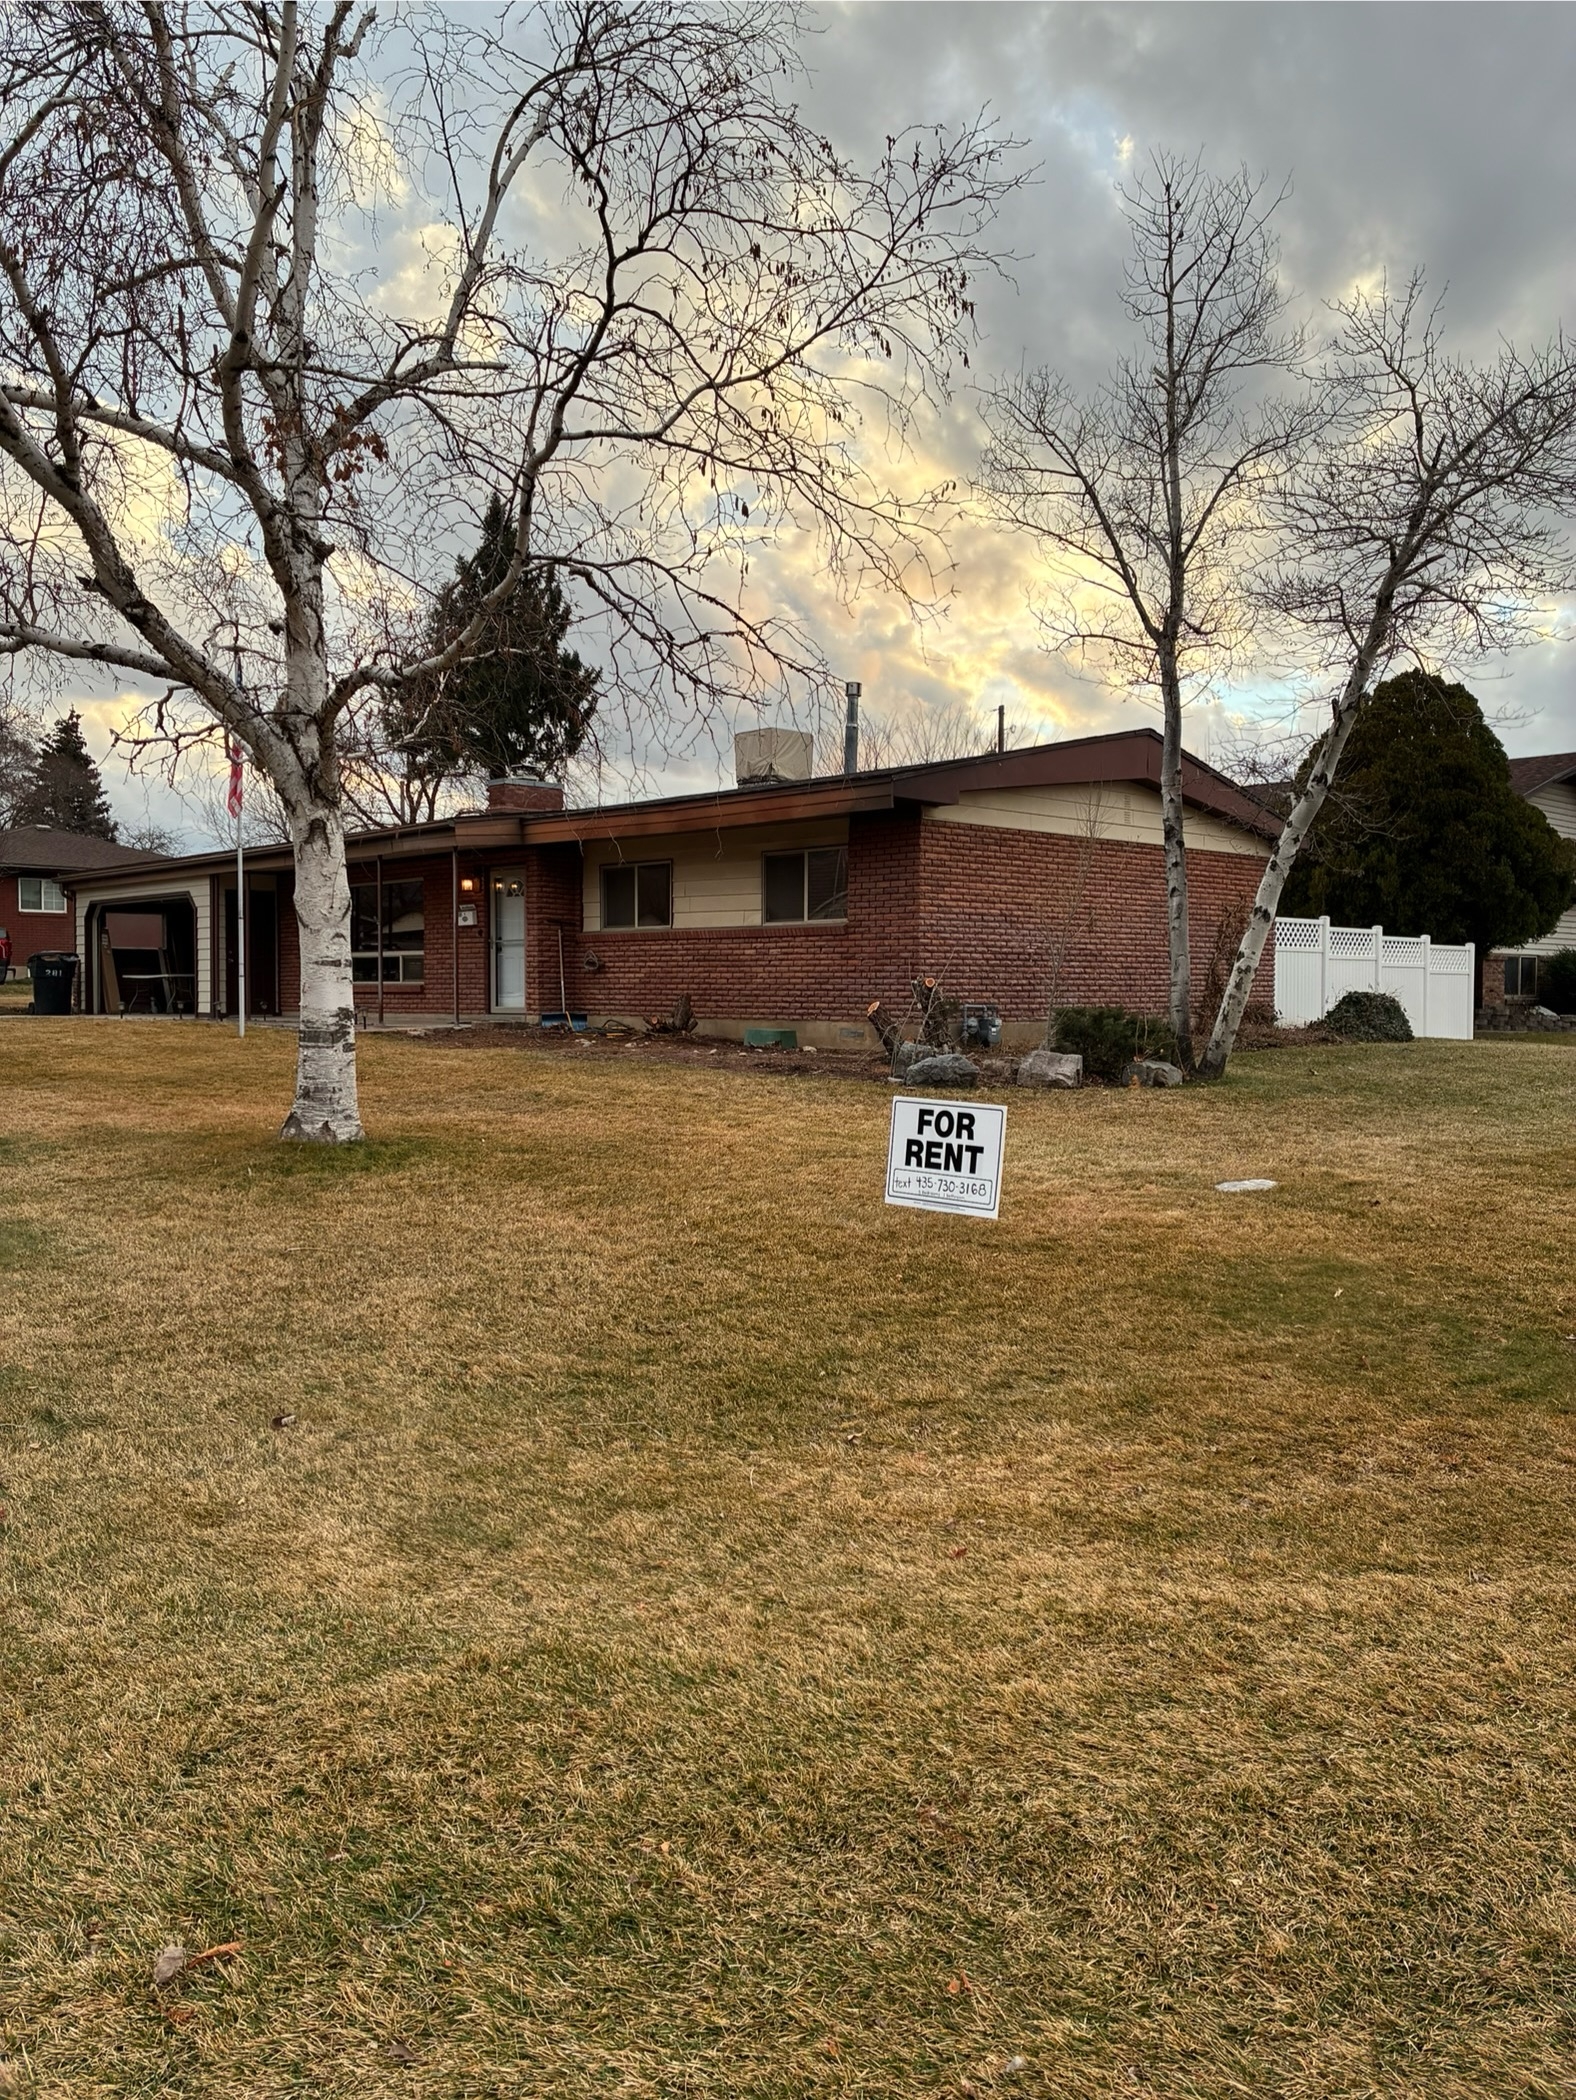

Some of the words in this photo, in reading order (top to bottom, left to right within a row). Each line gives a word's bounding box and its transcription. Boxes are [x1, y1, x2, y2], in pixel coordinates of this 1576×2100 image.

[917, 1108, 976, 1141] FOR
[904, 1138, 985, 1175] RENT
[894, 1176, 912, 1189] text
